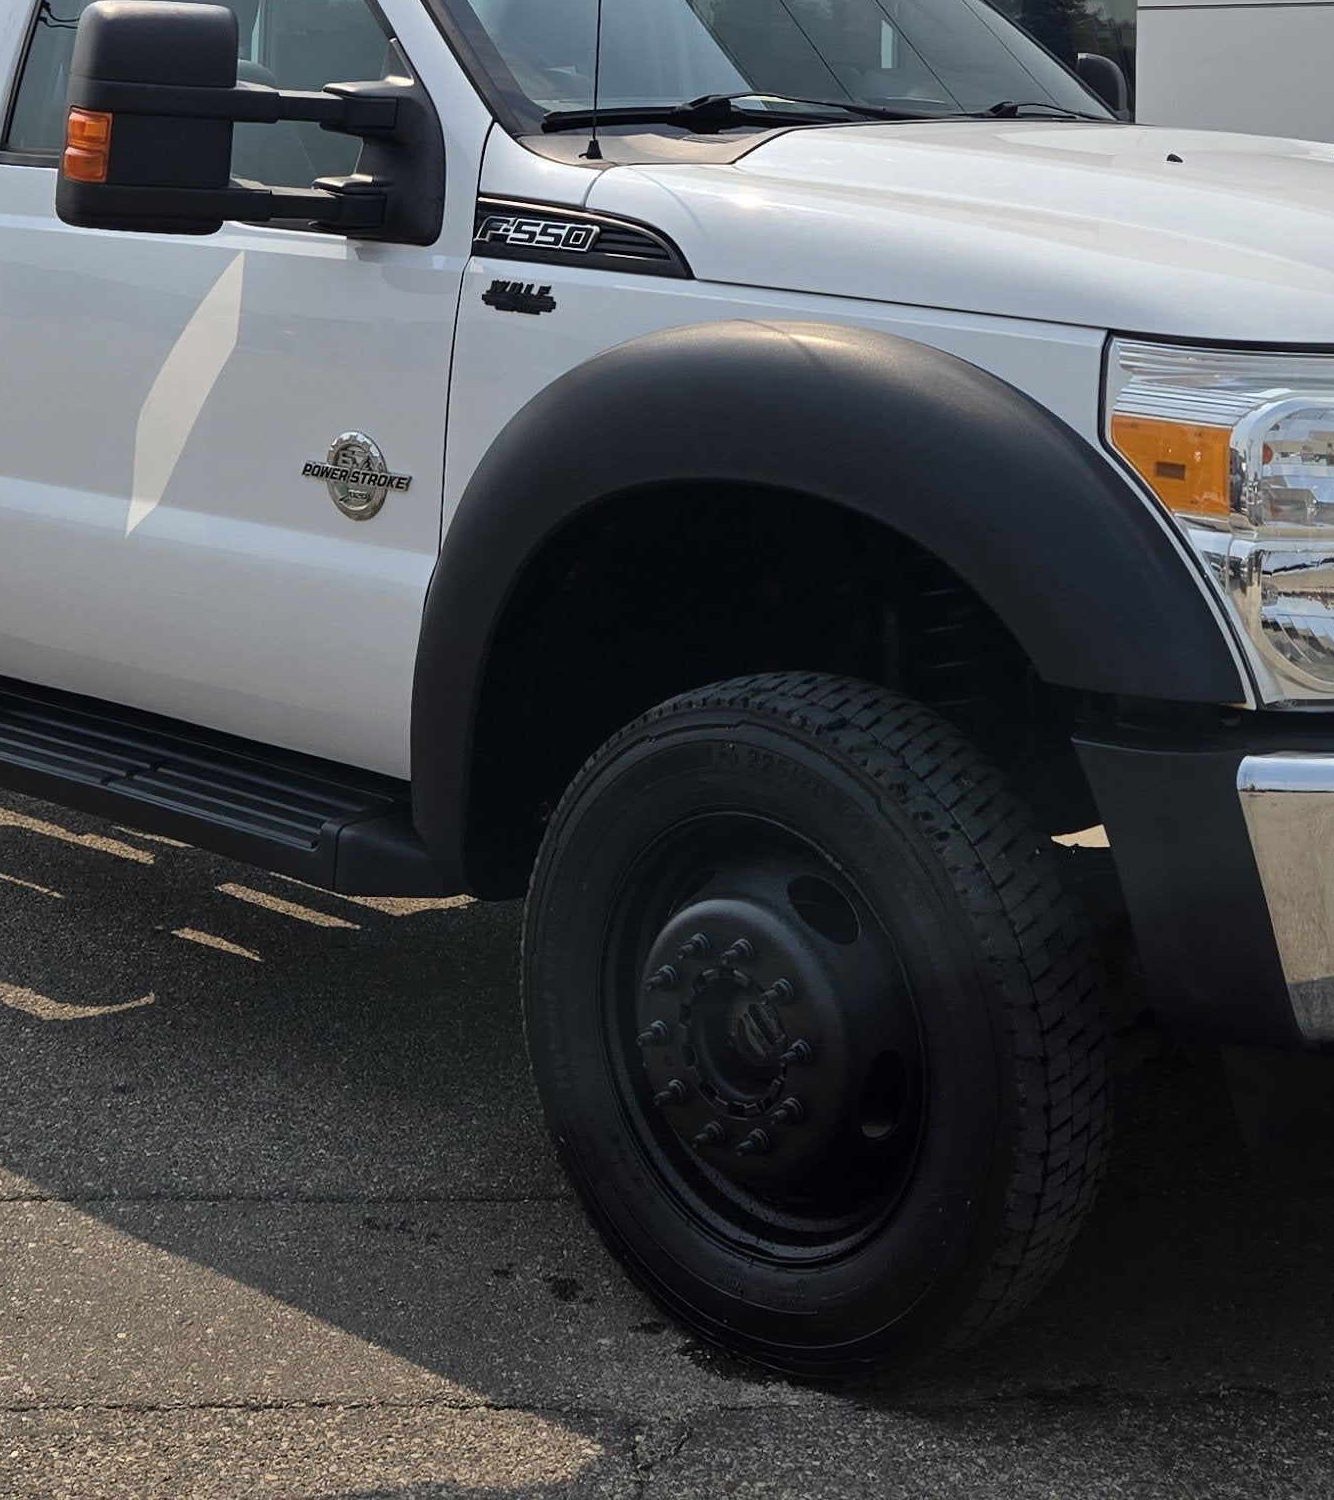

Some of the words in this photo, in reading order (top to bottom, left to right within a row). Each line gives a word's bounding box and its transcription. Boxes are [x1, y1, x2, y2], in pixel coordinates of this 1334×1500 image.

[473, 215, 600, 252] F-550
[301, 461, 349, 482] POWER
[350, 470, 412, 492] STROKE
